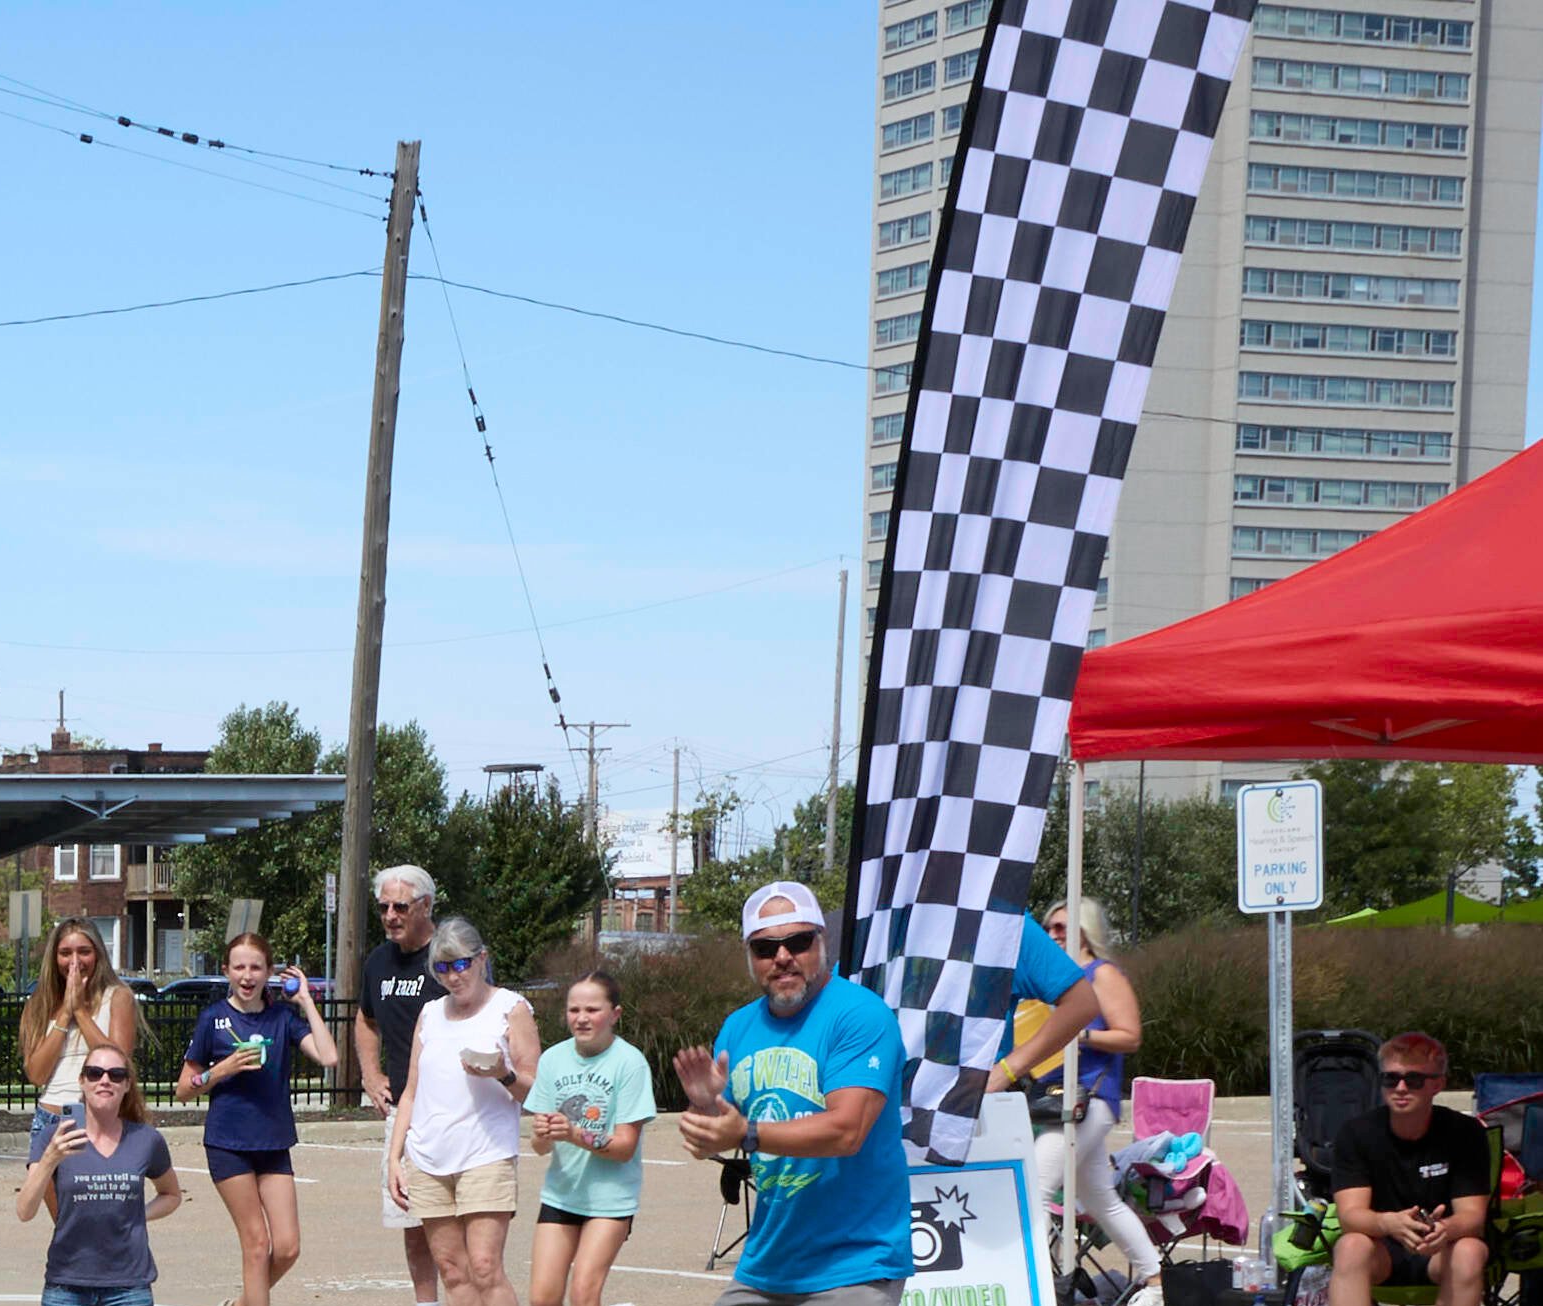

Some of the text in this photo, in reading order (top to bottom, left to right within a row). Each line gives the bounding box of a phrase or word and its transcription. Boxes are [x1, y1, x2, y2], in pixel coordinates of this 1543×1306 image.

[1254, 861, 1307, 876] PARKING
[1265, 881, 1297, 895] ONLY
[380, 974, 425, 1000] got zaza?
[554, 1072, 615, 1096] HOLY NAME
[754, 1046, 827, 1110] WHEEL
[73, 1175, 90, 1184] you
[91, 1174, 113, 1182] can't
[114, 1173, 129, 1182] tell
[87, 1182, 131, 1191] what to do
[73, 1193, 98, 1202] you're
[99, 1193, 113, 1201] not
[114, 1193, 127, 1202] my
